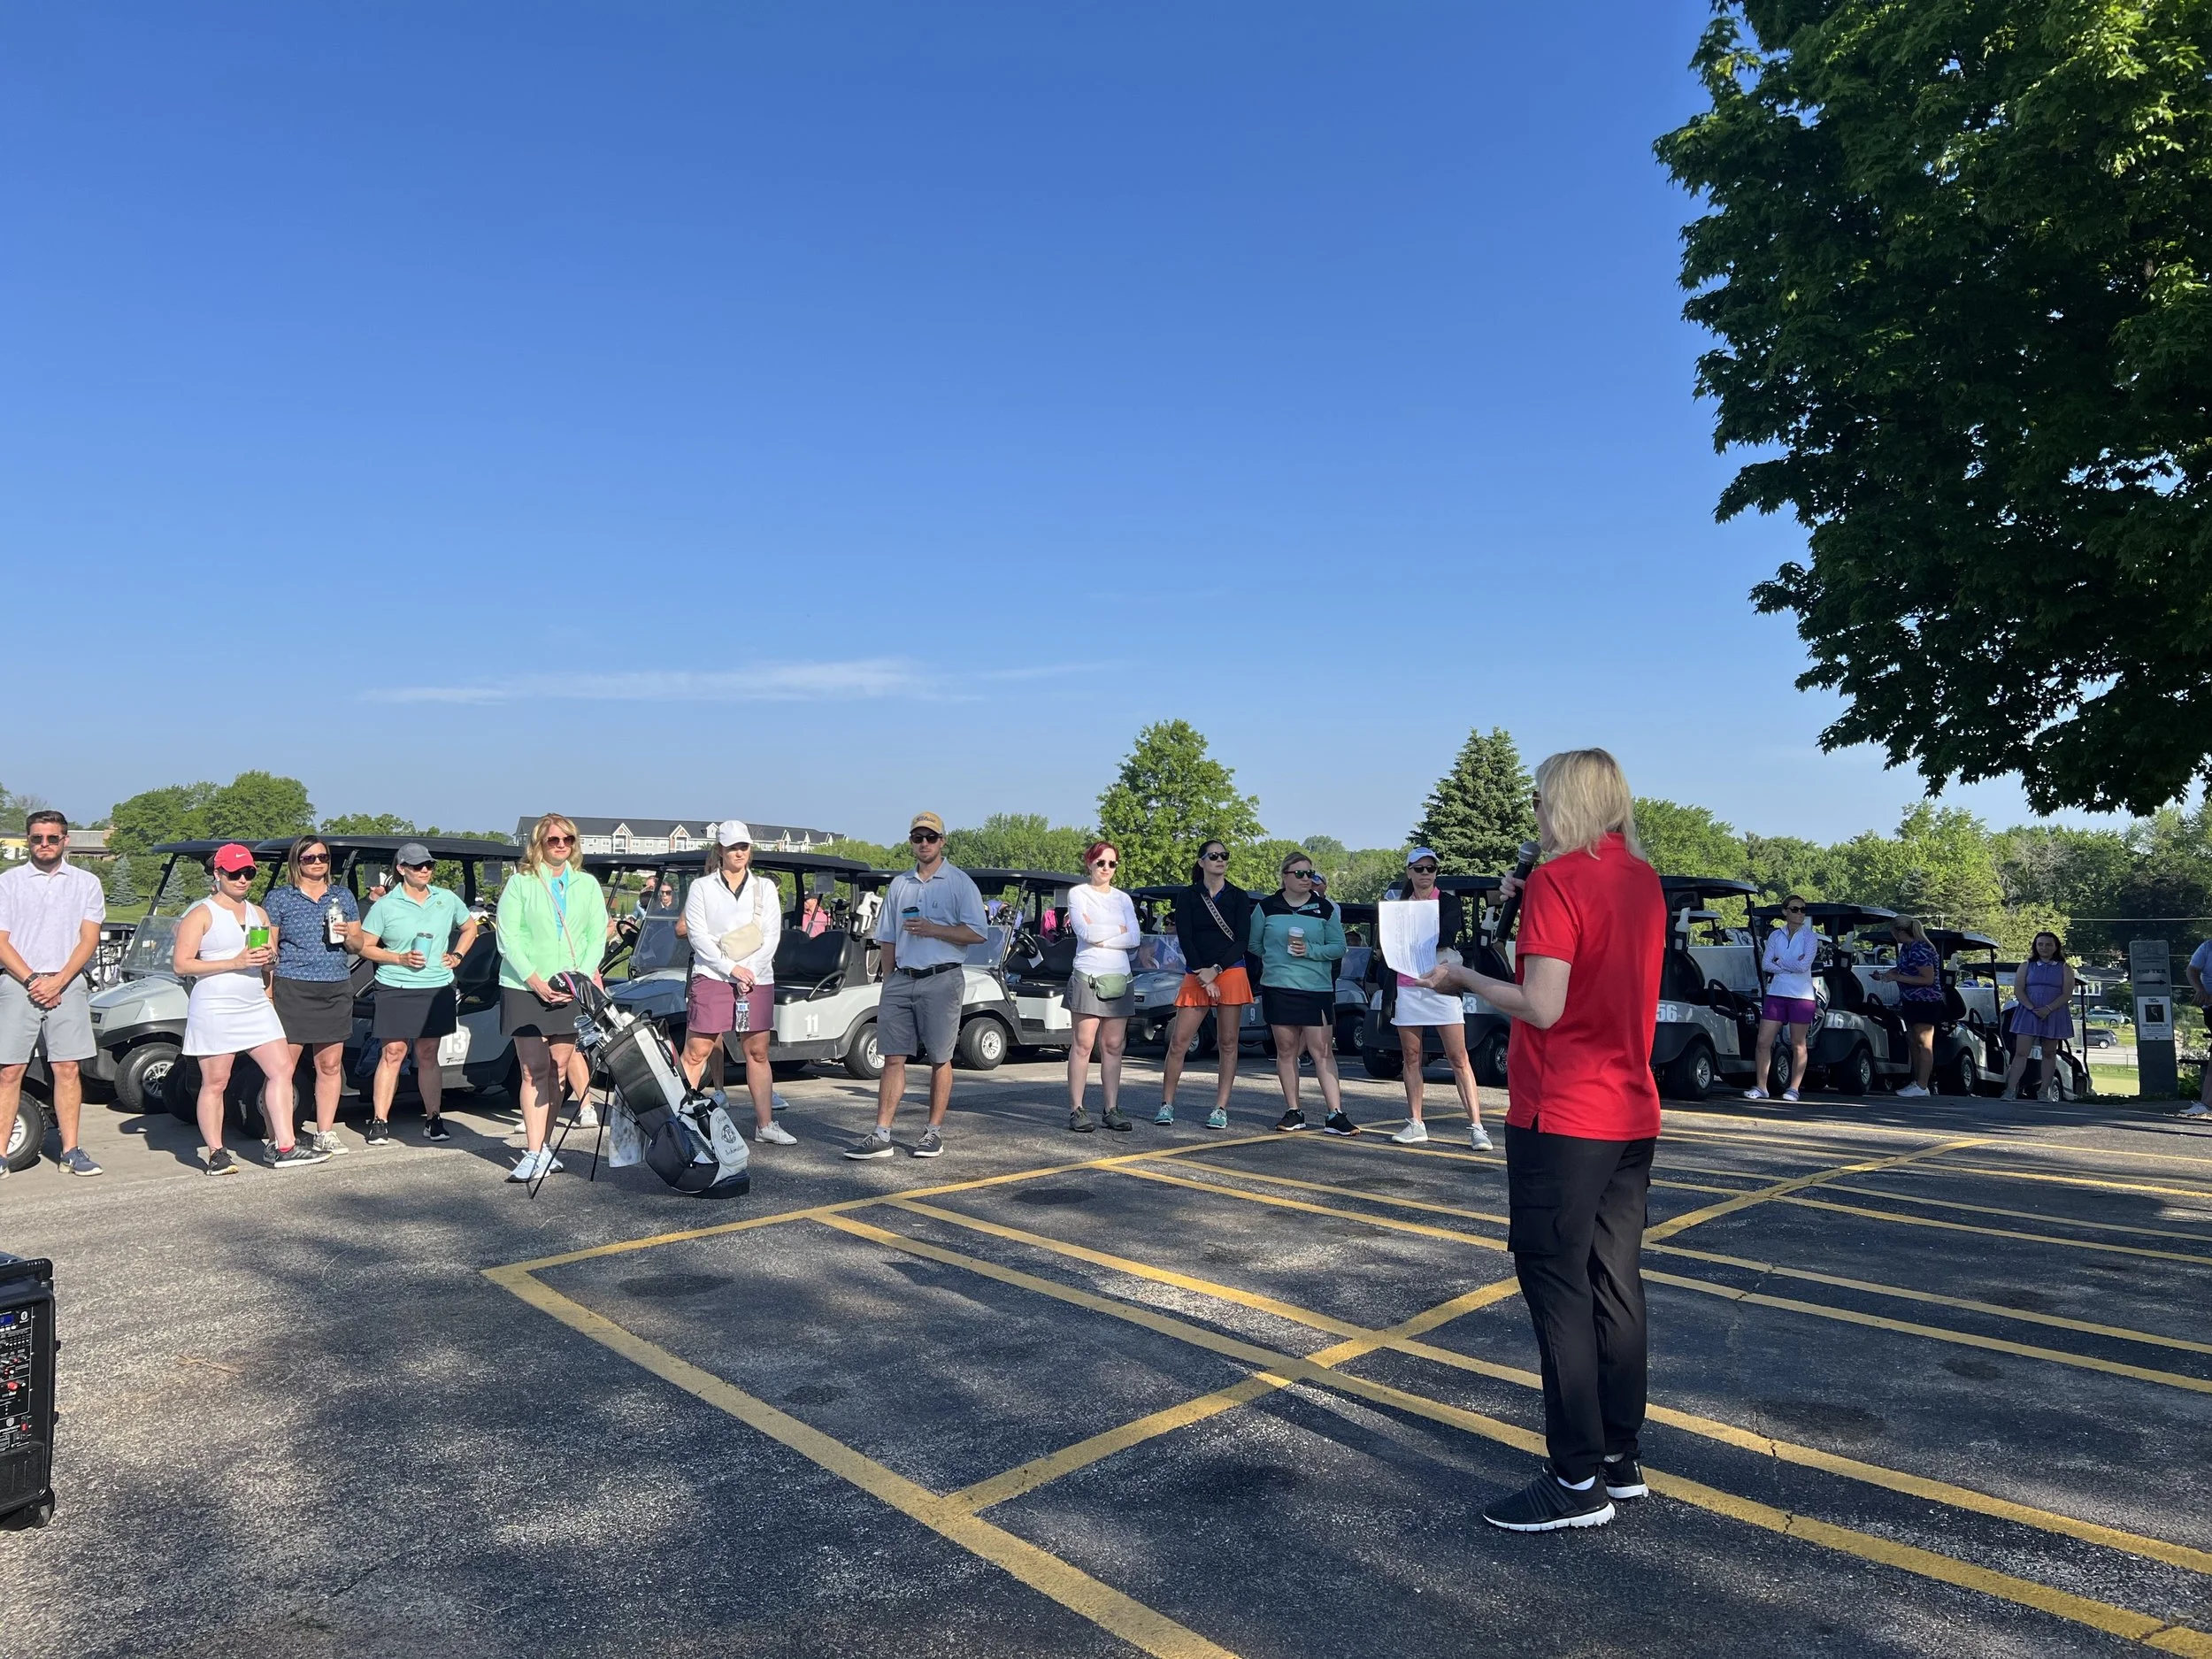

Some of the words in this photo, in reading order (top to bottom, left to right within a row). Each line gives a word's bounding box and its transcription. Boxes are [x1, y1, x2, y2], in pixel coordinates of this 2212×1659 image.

[1250, 1007, 1256, 1021] 9
[1656, 1004, 1678, 1022] 56
[1825, 1012, 1844, 1028] 76
[804, 1013, 818, 1033] 11
[446, 1031, 467, 1054] 13
